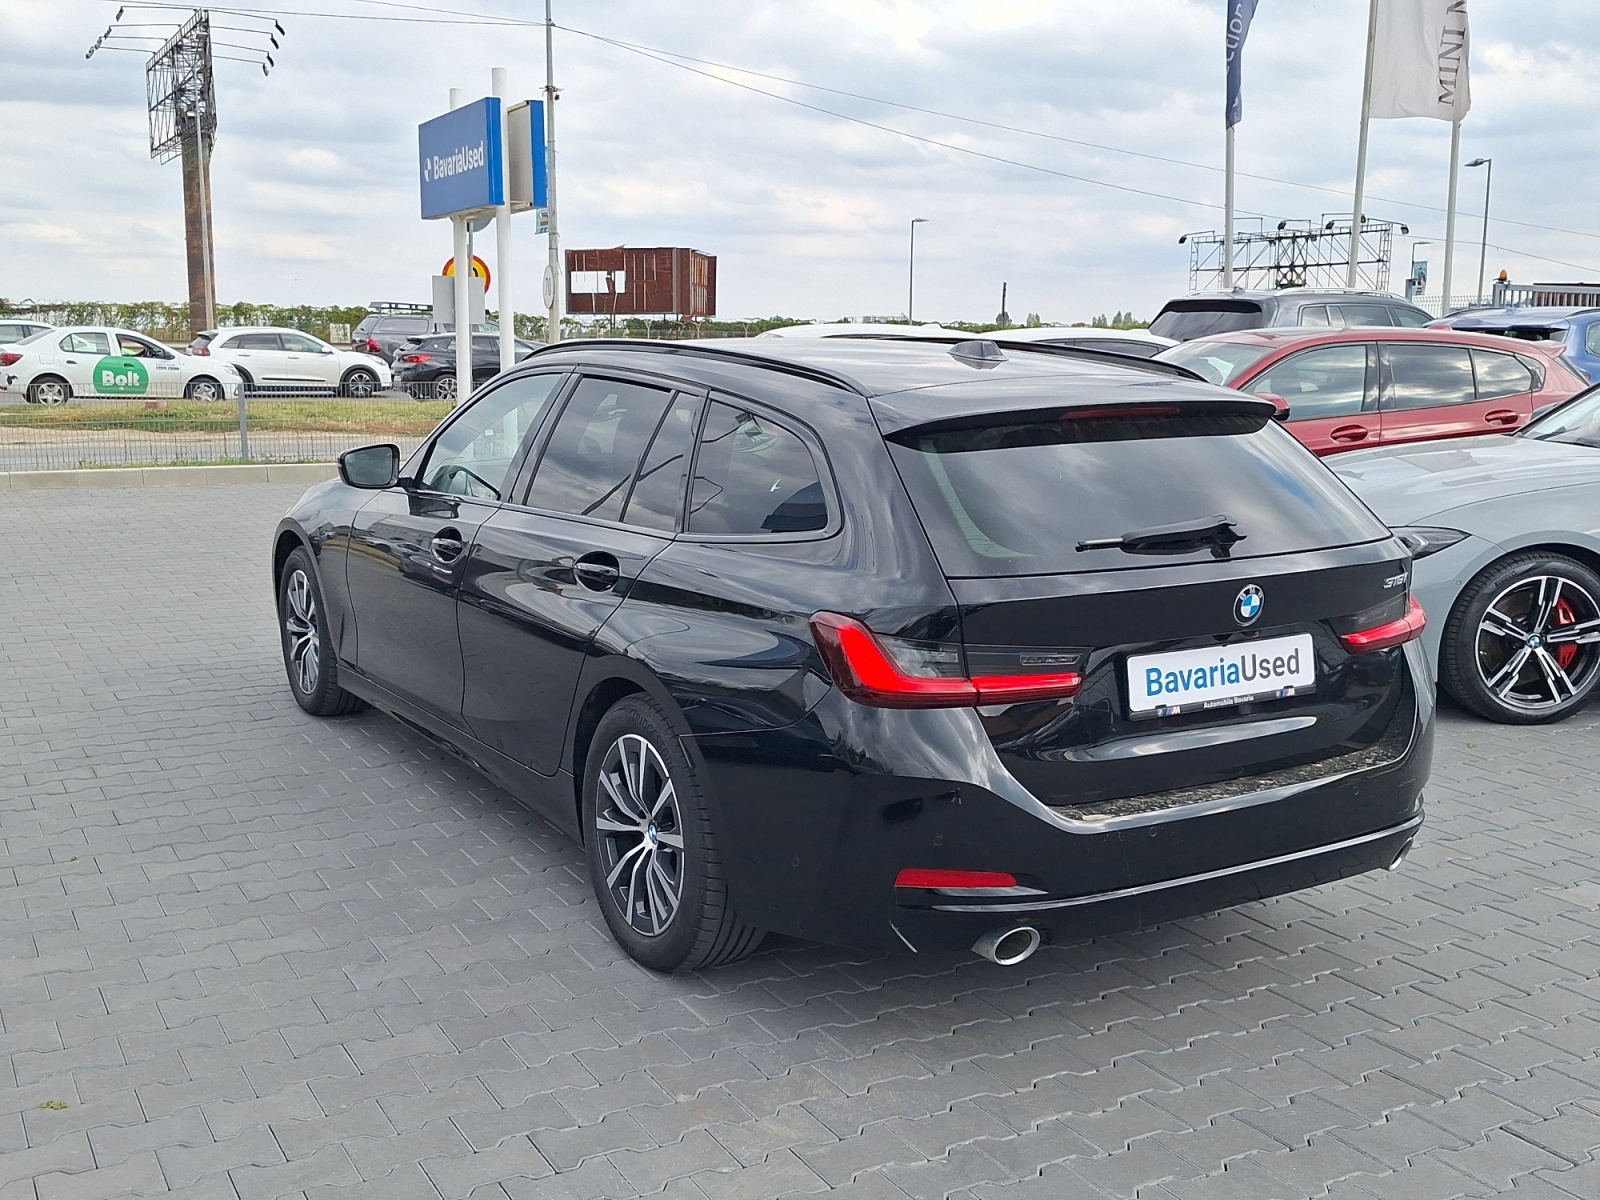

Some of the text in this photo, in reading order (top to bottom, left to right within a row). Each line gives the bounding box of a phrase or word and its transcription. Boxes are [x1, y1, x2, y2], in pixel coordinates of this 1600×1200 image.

[1437, 25, 1466, 107] MINI
[433, 140, 484, 180] BavariaUsed
[102, 370, 141, 387] Bolt
[1145, 648, 1300, 697] BavariaUsed
[1203, 695, 1254, 709] Automobile Bavaria
